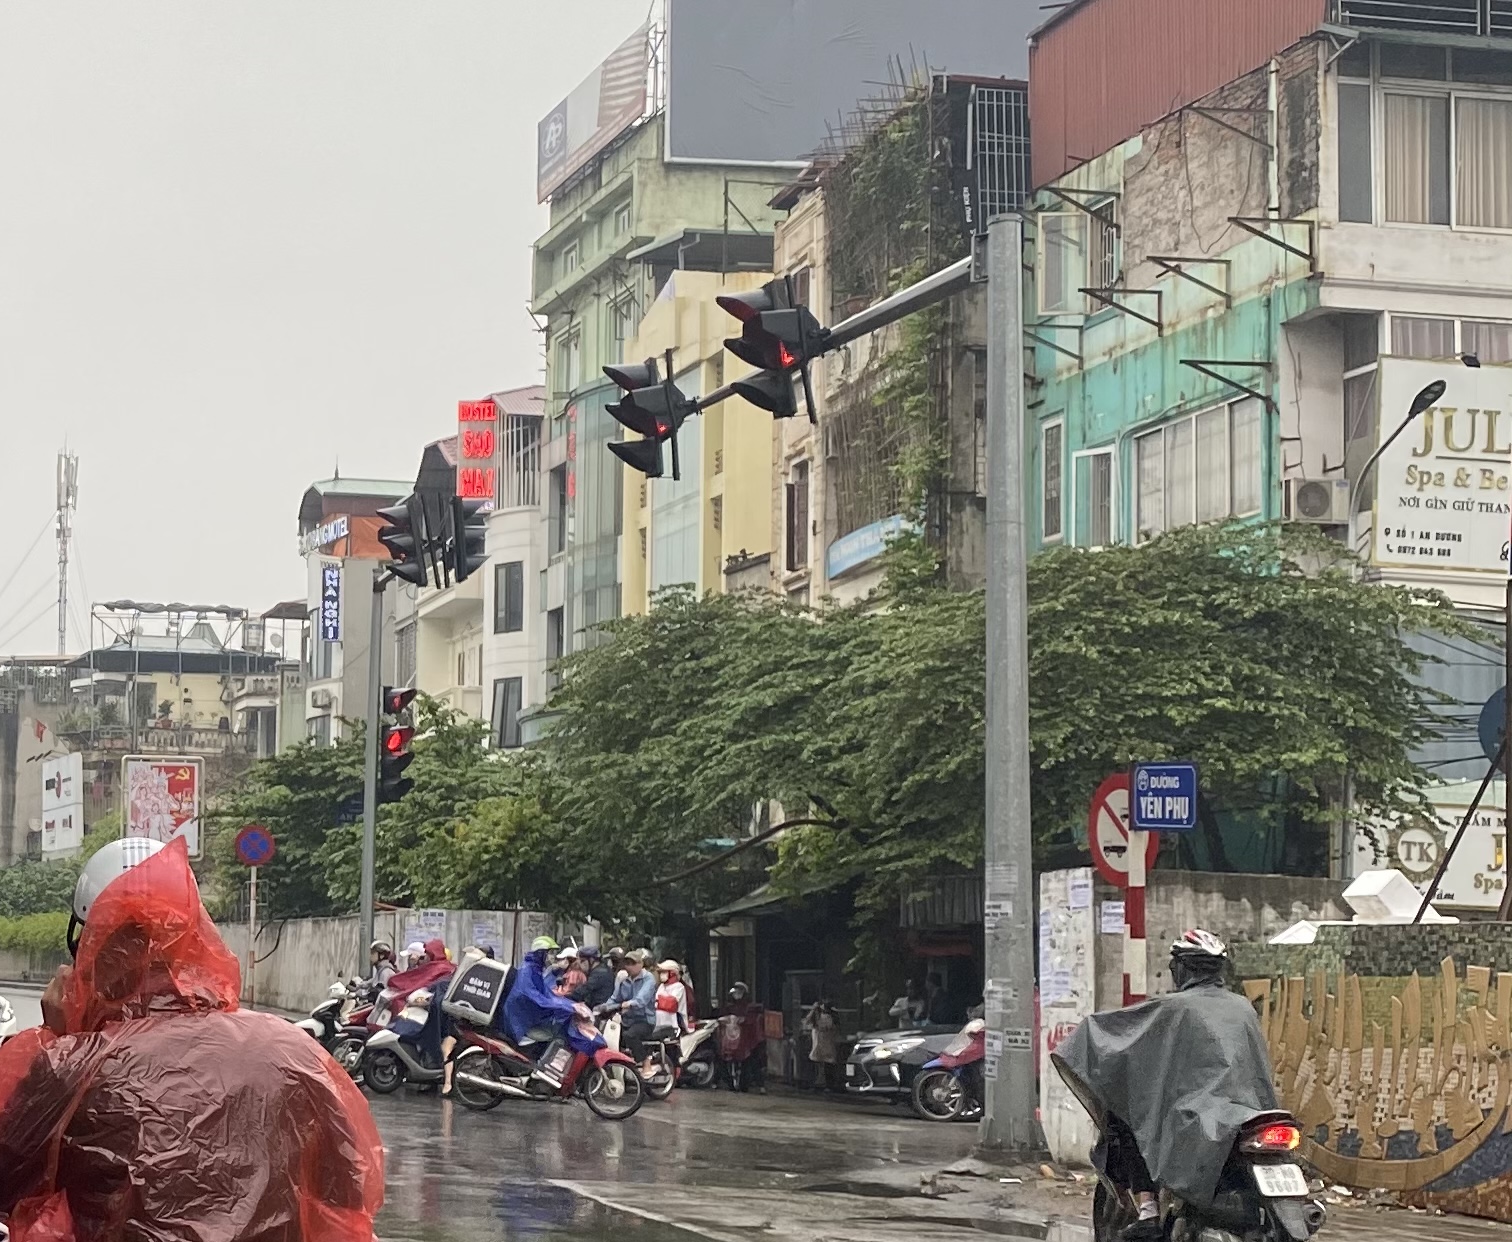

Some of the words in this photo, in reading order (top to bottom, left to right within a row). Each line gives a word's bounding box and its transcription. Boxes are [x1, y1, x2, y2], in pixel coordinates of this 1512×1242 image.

[458, 402, 496, 420] HOSTEL
[1405, 464, 1445, 491] Spa
[1454, 467, 1472, 488] &
[1140, 791, 1162, 819] YÊN
[1165, 796, 1189, 825] PHỤ
[1401, 840, 1435, 862] TK
[1473, 872, 1504, 894] Spa
